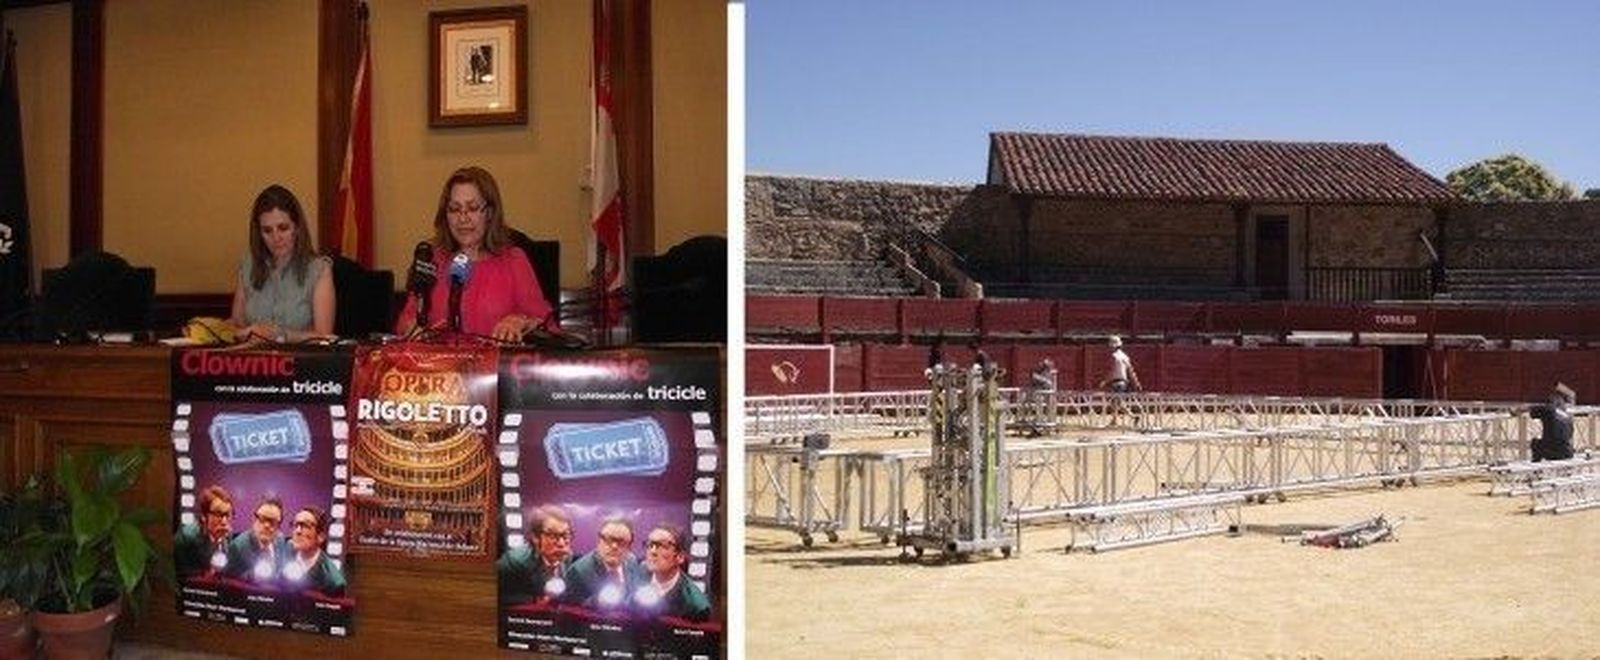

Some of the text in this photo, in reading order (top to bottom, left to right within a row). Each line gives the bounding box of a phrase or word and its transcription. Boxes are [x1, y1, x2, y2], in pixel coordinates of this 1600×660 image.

[181, 350, 295, 376] Clownic
[510, 352, 650, 380] Clnic
[292, 380, 343, 395] tricicle
[647, 386, 707, 401] tricicle
[357, 398, 488, 426] RIGOLETTO
